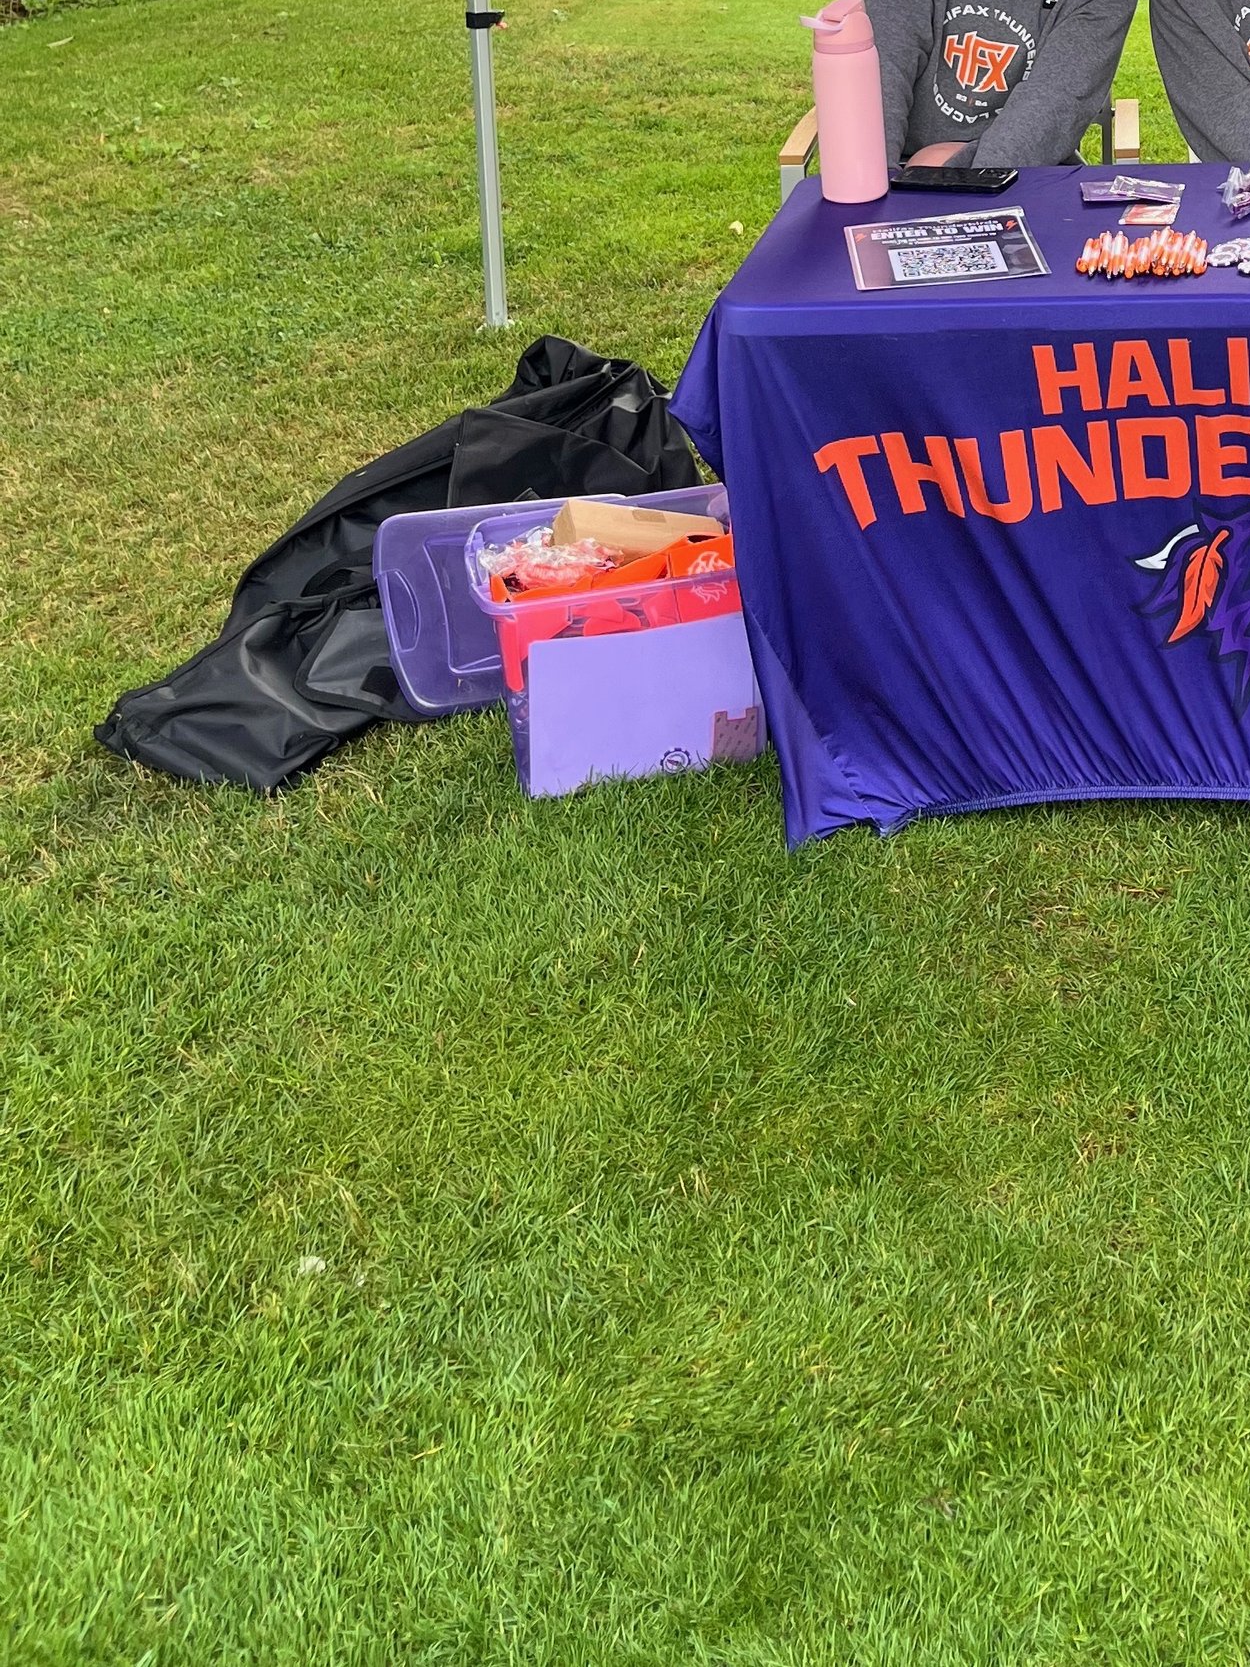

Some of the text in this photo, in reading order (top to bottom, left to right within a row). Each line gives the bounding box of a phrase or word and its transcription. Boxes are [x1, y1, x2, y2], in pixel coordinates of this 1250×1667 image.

[943, 31, 1020, 92] HFX
[871, 229, 927, 241] ENTER
[935, 227, 958, 236] TO
[963, 223, 1004, 234] WIN
